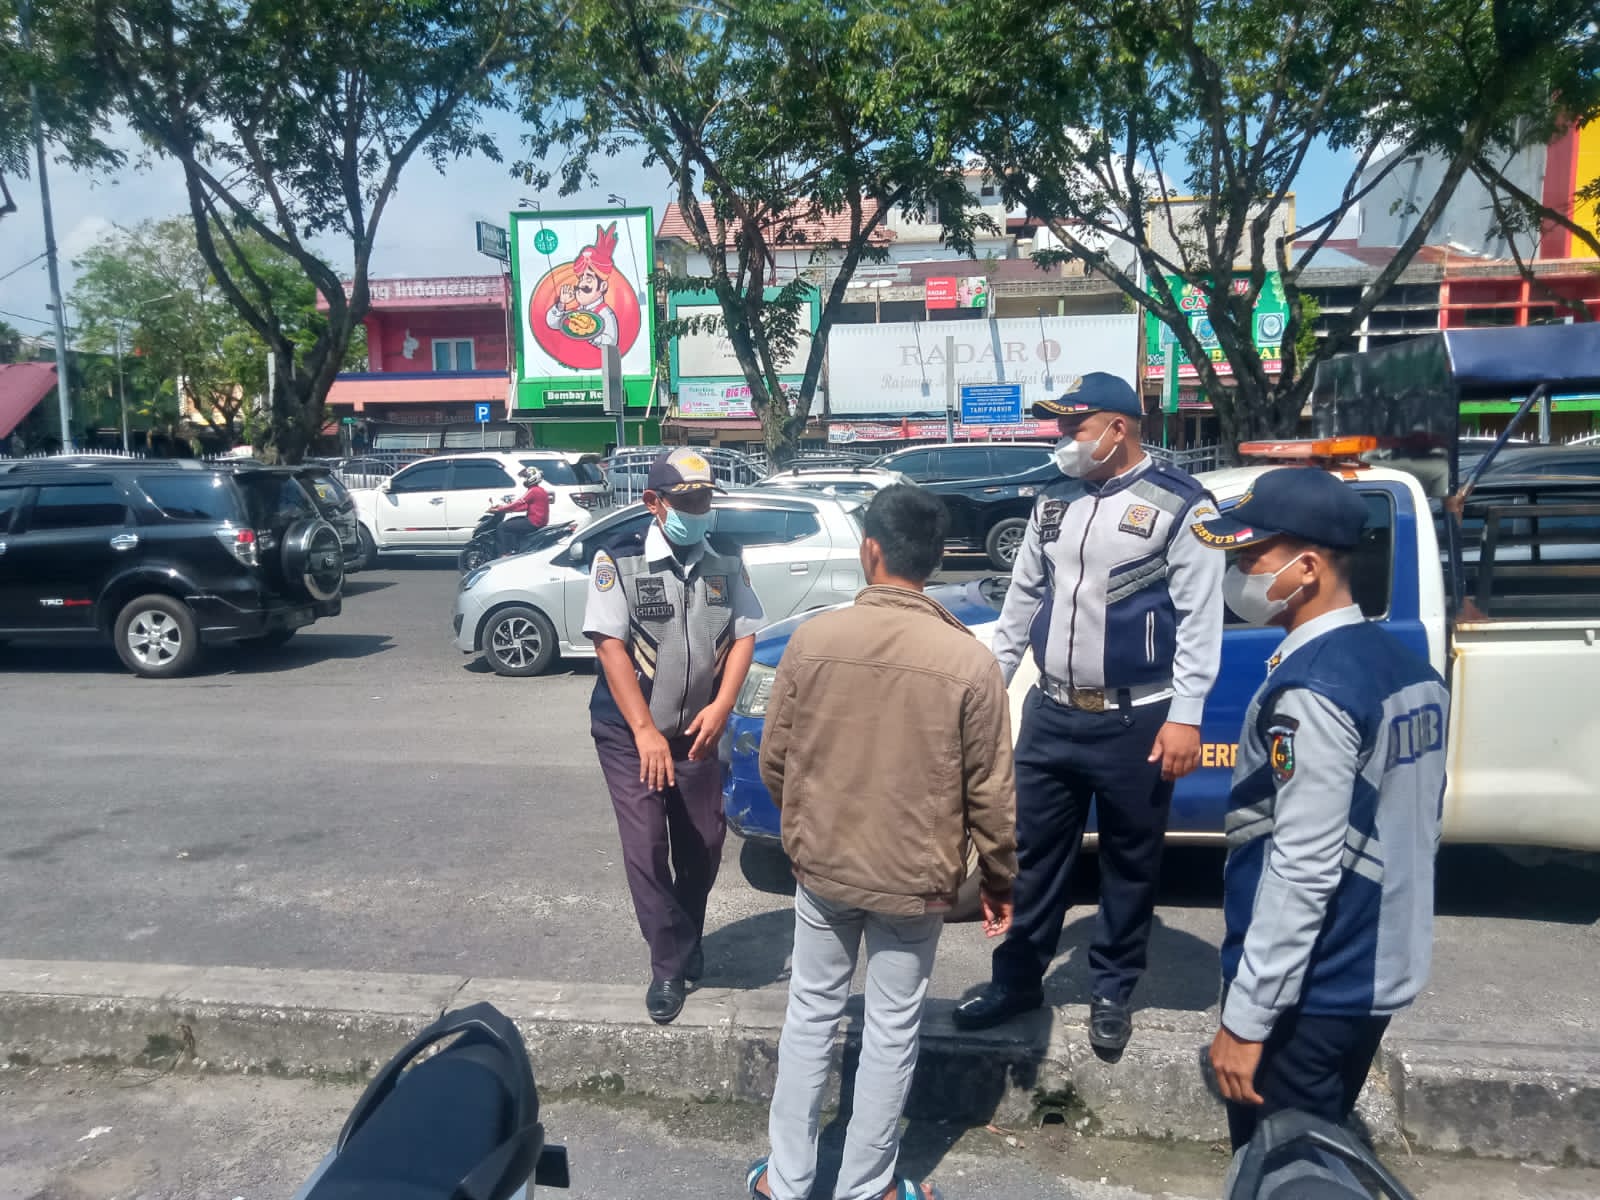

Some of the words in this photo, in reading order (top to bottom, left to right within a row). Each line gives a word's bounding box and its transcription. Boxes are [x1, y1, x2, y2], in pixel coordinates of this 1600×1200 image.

[395, 279, 488, 297] Indonesia
[899, 342, 1028, 366] RADAR
[547, 391, 586, 400] Bombay
[726, 388, 739, 398] BIG
[478, 406, 489, 420] P
